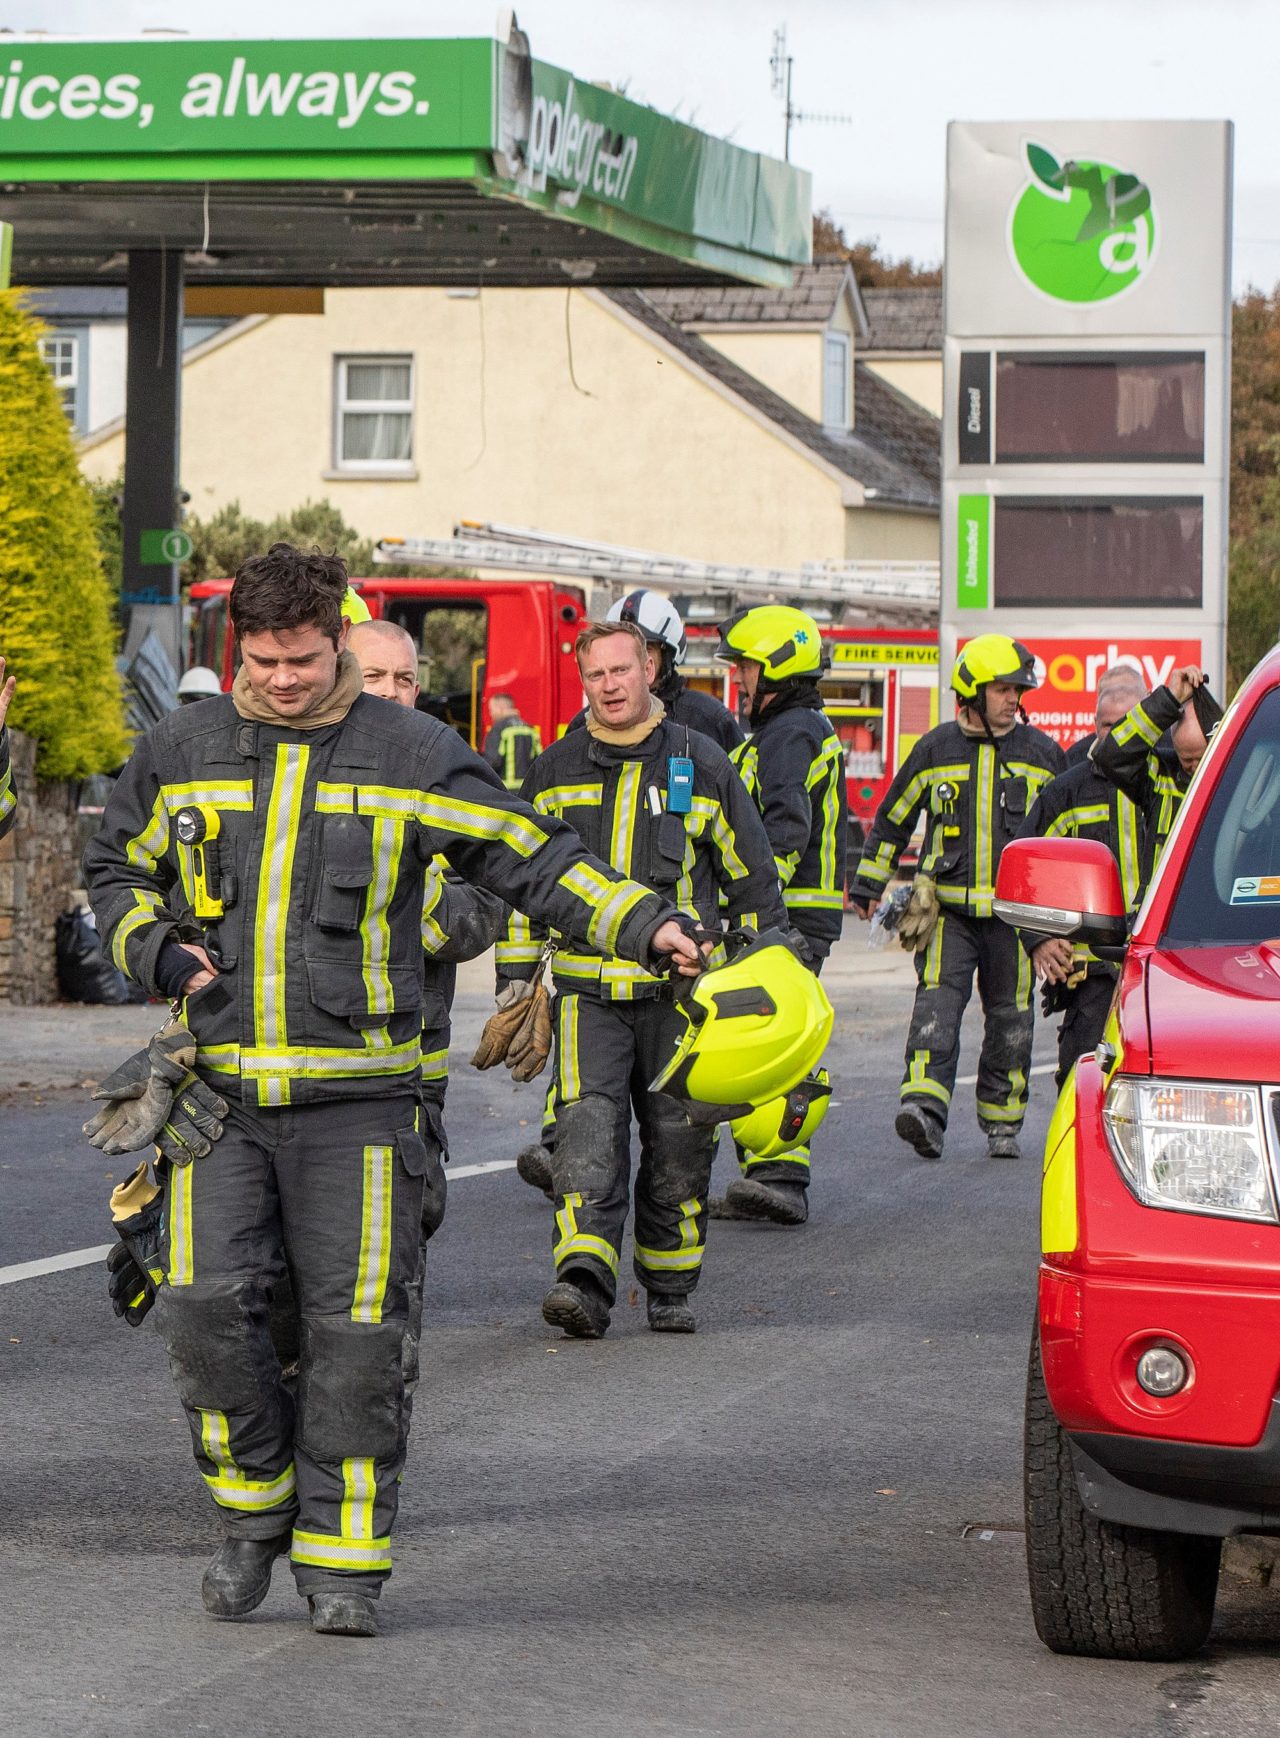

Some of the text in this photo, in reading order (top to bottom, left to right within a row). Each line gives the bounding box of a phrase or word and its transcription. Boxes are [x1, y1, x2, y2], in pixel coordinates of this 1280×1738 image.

[180, 56, 430, 129] always.
[527, 79, 638, 209] pplegreen
[967, 387, 981, 434] Diesel
[965, 519, 979, 587] Unleaded
[845, 648, 880, 659] FIRE
[1028, 712, 1096, 727] OUGH SU
